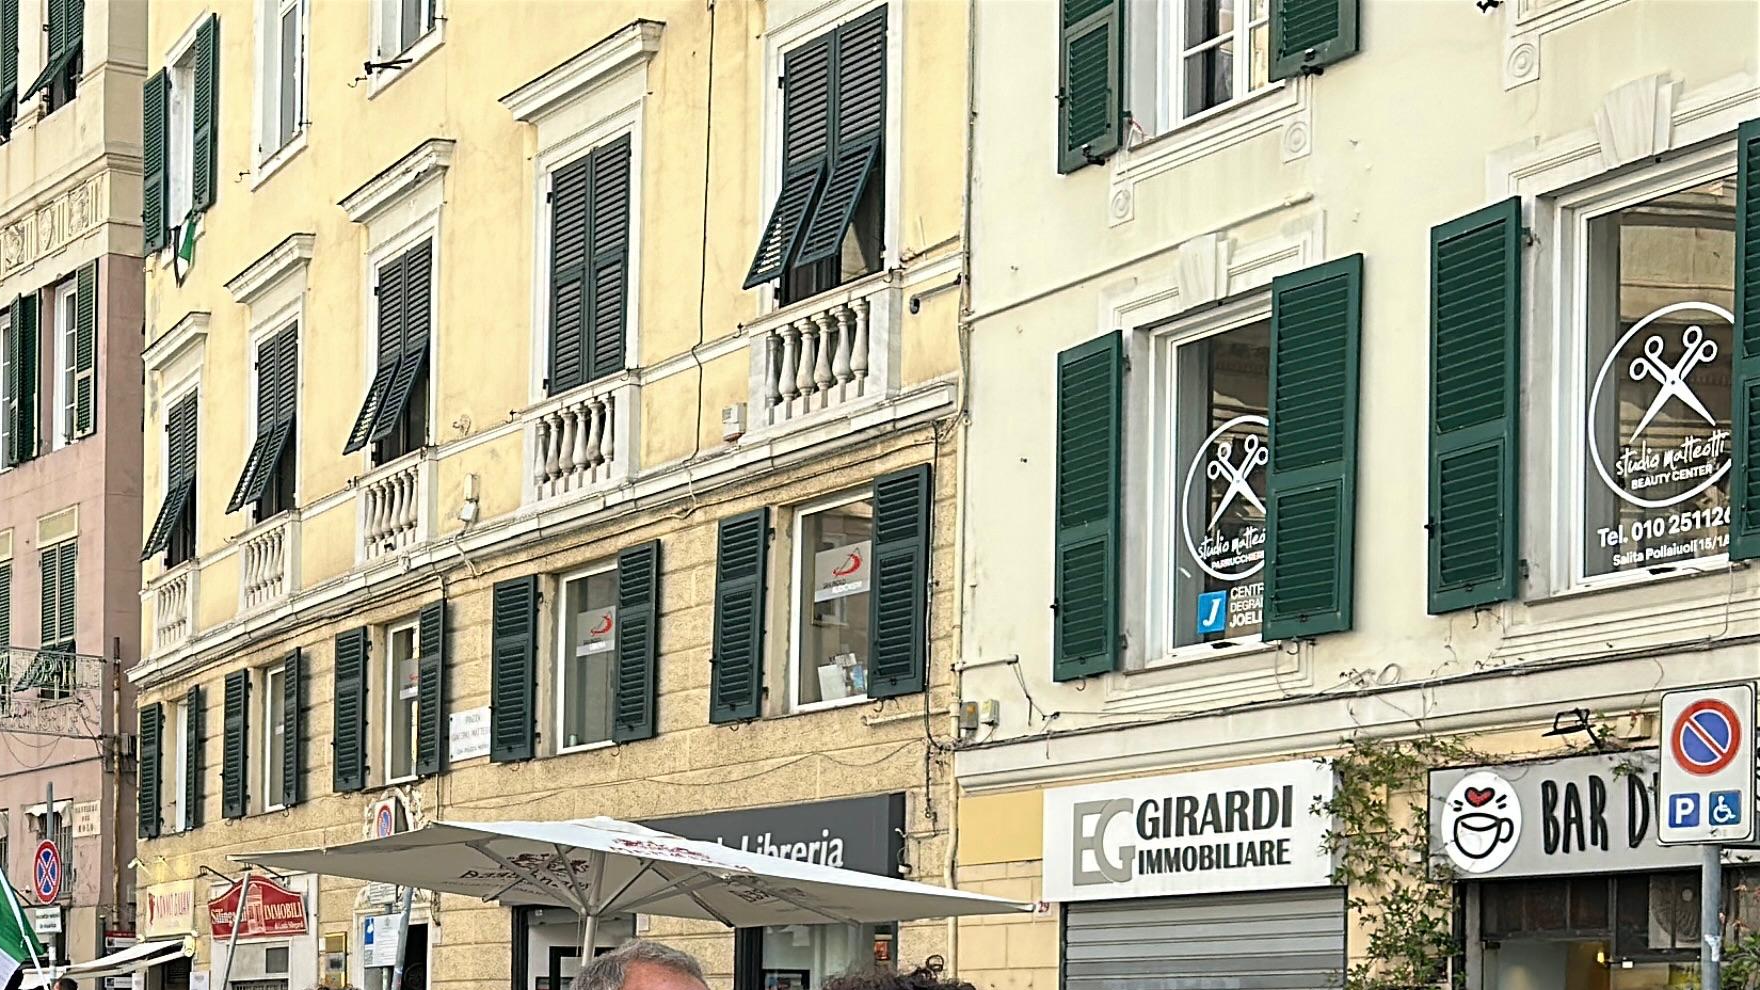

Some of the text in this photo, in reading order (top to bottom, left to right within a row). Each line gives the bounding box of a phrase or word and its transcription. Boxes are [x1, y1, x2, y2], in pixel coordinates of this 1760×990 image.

[1615, 430, 1730, 477] studio matteotti
[1631, 464, 1713, 490] BEAUTY CENTER
[1198, 529, 1229, 559] studio
[1597, 525, 1628, 547] Tel.
[1631, 518, 1665, 541] 010
[1613, 551, 1644, 566] Salita
[1202, 598, 1222, 626] J
[1136, 785, 1293, 840] GIRARDI
[1541, 774, 1608, 855] BAR
[1675, 798, 1695, 825] P
[1138, 838, 1292, 875] IMMOBILIARE
